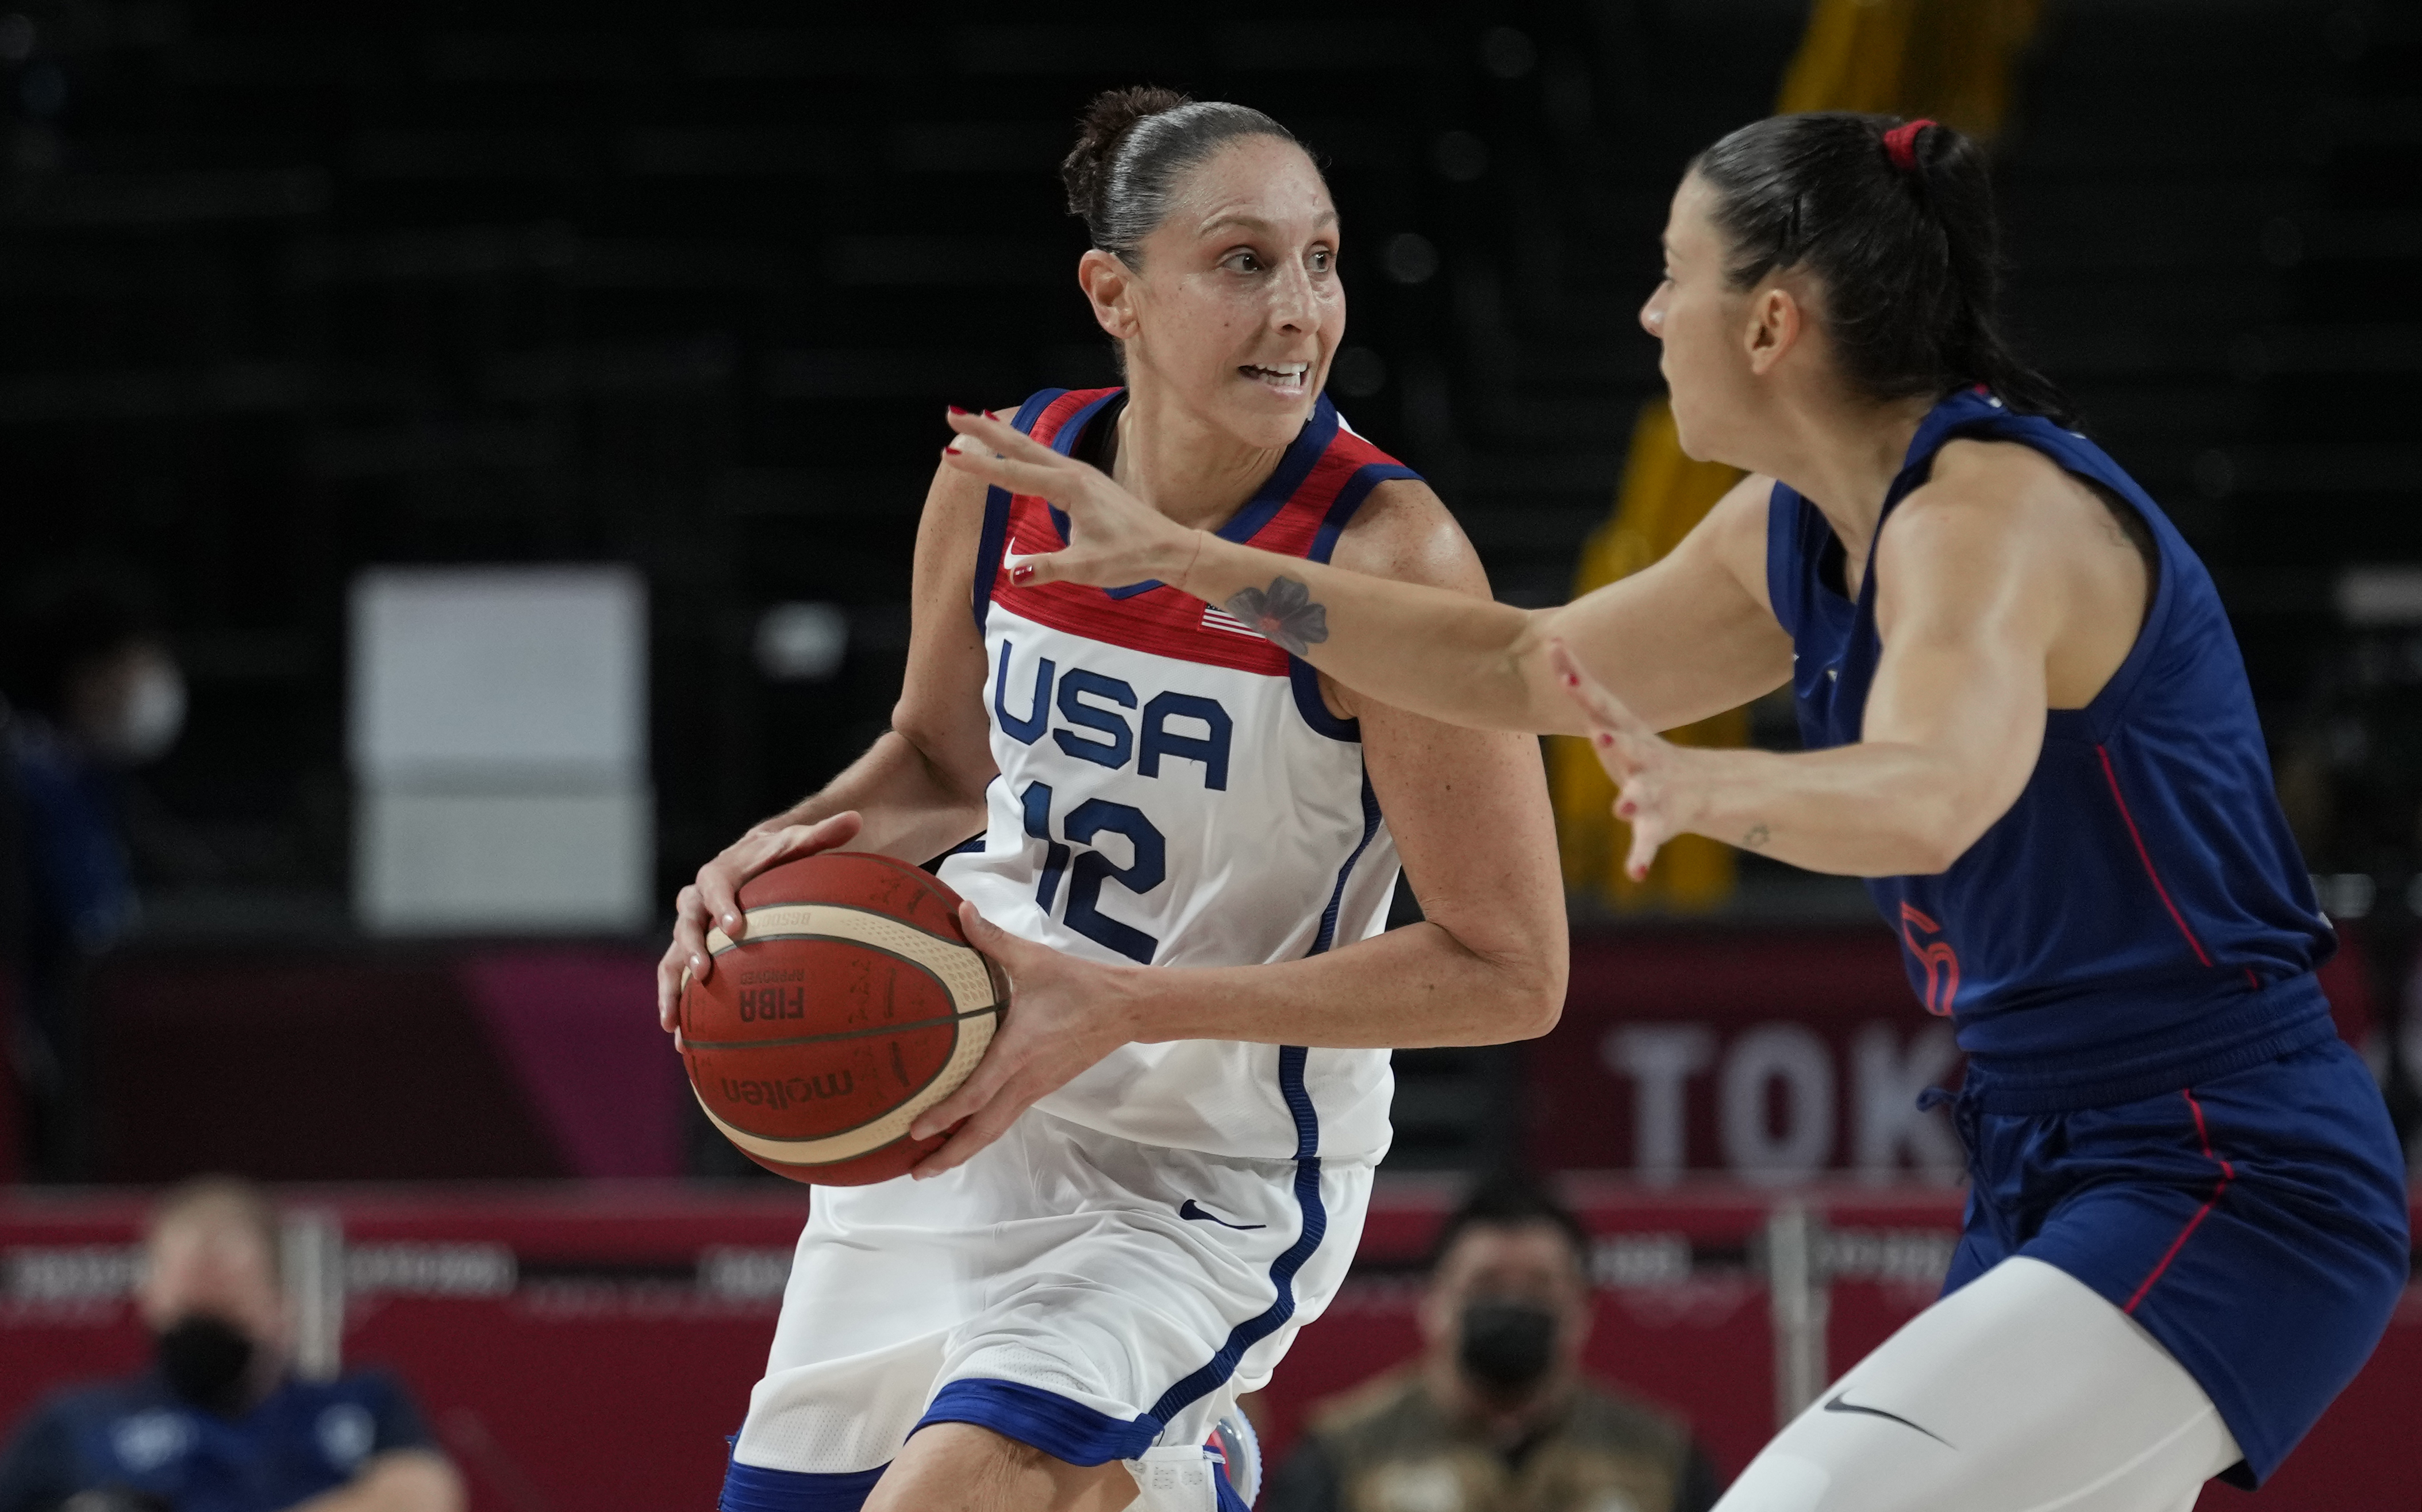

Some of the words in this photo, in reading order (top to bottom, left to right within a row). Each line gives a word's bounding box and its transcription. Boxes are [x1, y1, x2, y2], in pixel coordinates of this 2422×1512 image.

[994, 638, 1233, 791] USA
[1020, 780, 1166, 965] 12
[740, 969, 805, 985] APPROVED
[739, 987, 804, 1022] FIBA
[721, 1069, 854, 1110] molten
